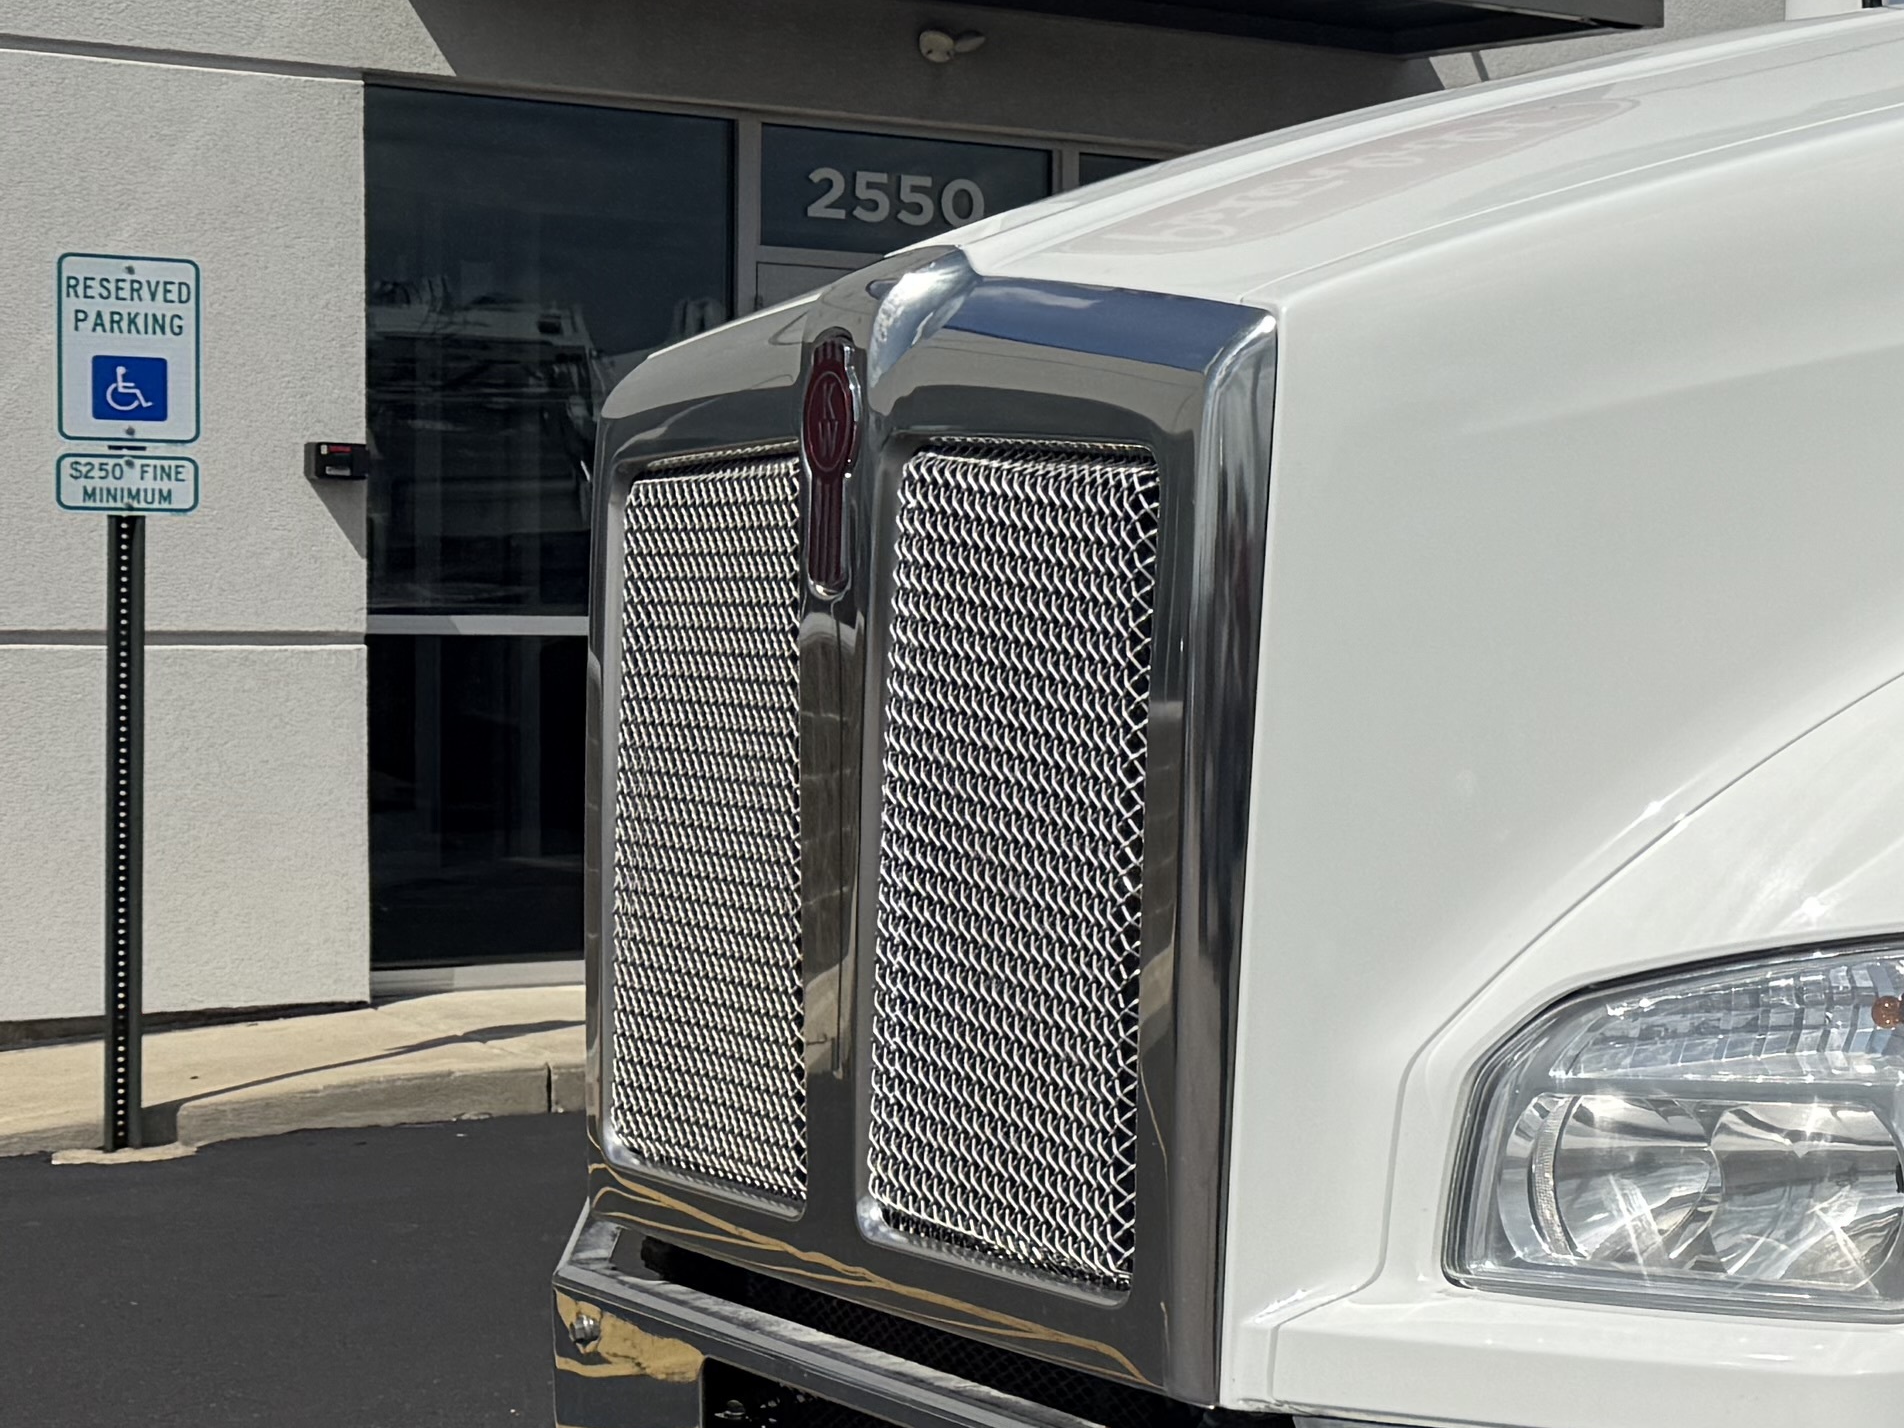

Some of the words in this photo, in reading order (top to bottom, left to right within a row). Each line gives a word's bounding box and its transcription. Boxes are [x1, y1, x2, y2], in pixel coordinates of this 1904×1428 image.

[807, 166, 985, 228] 2550
[65, 275, 191, 304] RESERVED
[73, 309, 184, 336] PARKING
[69, 460, 125, 482] $250
[139, 463, 186, 482] FINE
[81, 486, 173, 506] MINIMUM
